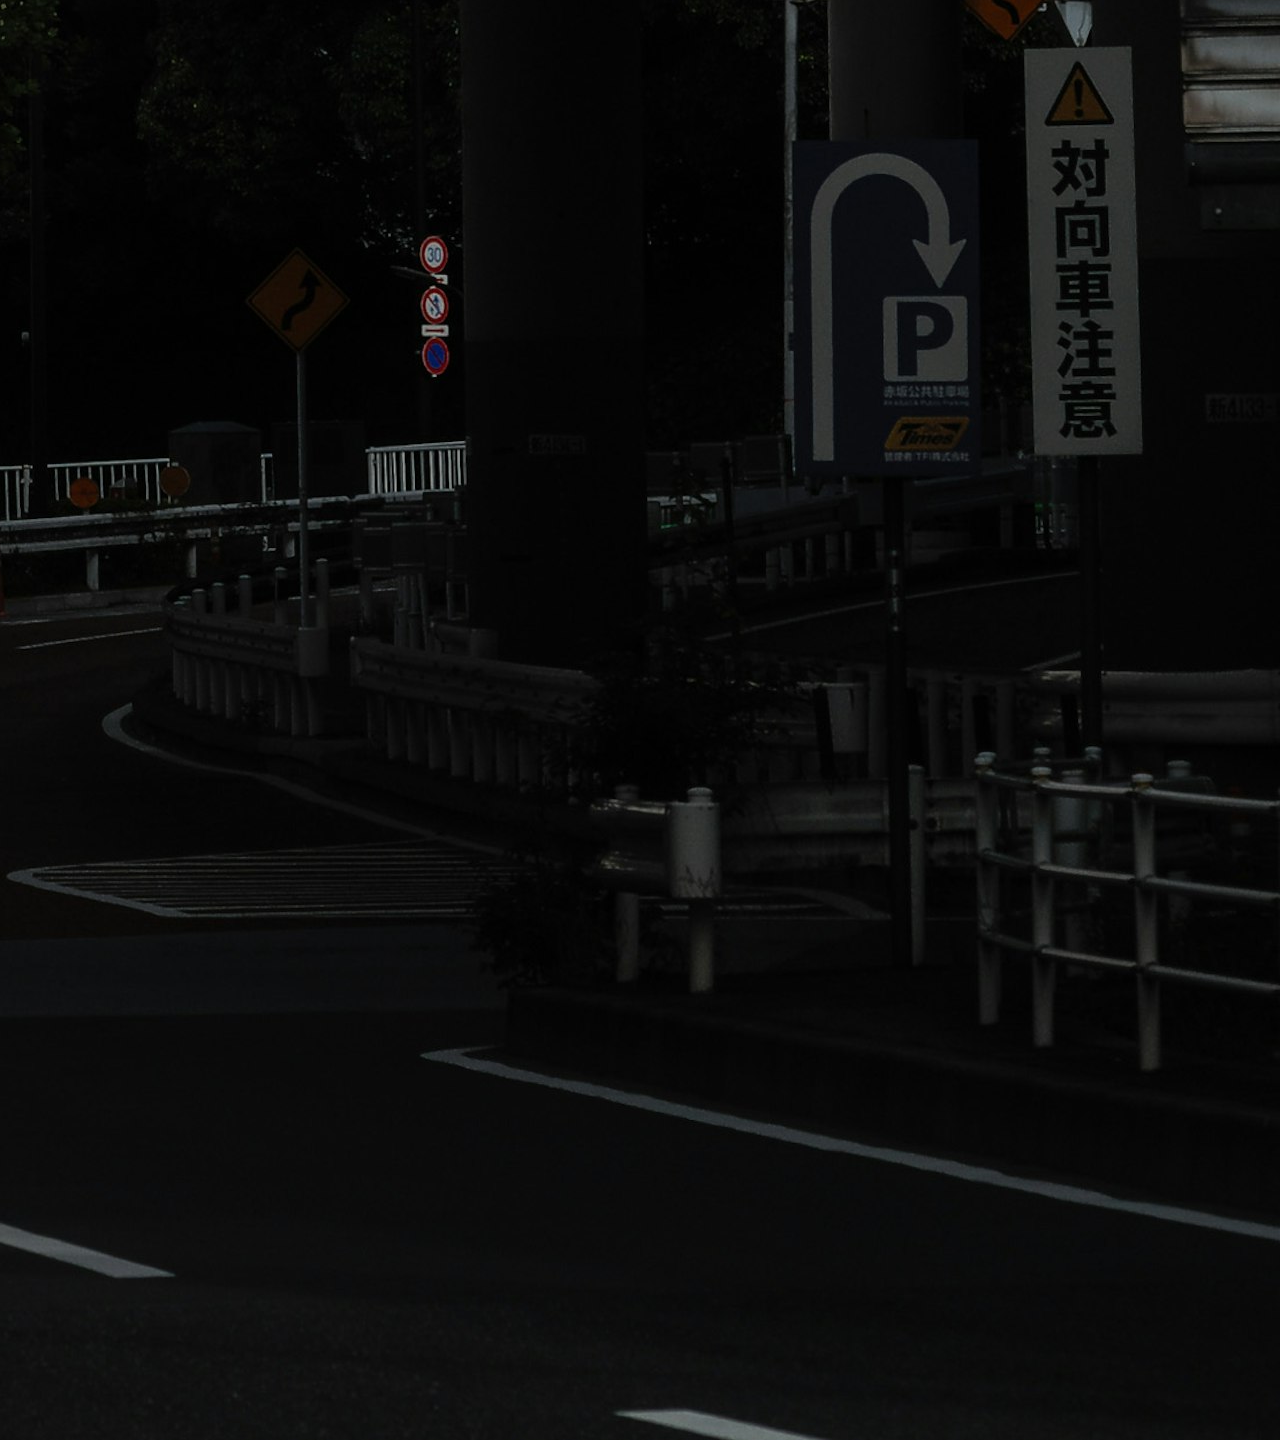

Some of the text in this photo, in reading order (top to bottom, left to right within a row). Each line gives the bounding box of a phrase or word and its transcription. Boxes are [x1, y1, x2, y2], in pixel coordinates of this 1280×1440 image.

[427, 247, 442, 263] 30
[1052, 139, 1117, 439] 対向車注意
[897, 301, 954, 376] P
[1208, 397, 1280, 420] 新4133-
[899, 424, 956, 446] Times
